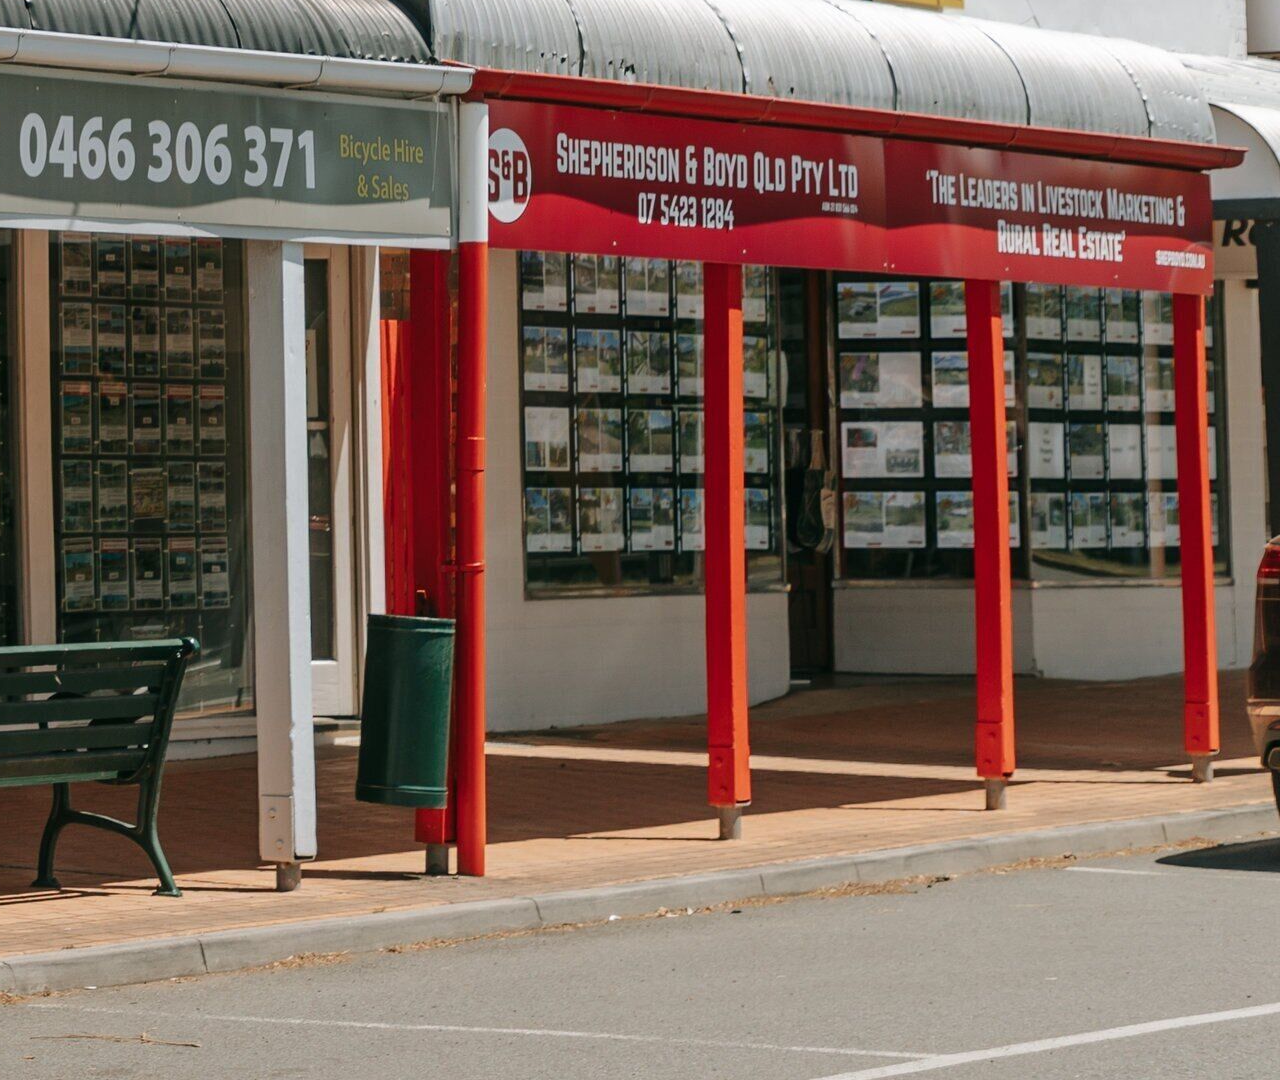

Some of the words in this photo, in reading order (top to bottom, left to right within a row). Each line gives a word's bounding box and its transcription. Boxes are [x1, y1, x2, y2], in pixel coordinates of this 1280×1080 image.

[19, 111, 136, 182] 0466
[147, 120, 233, 186] 306
[243, 125, 316, 190] 371
[340, 134, 391, 164] Bicycle
[394, 136, 425, 165] Hire
[556, 132, 680, 184] SHEPHERDSON
[686, 145, 698, 186] &
[703, 146, 748, 189] BOYD
[753, 151, 786, 195] QLD
[791, 155, 824, 195] PTY
[828, 158, 859, 199] LTD
[357, 175, 370, 199] &
[372, 174, 410, 201] Sales
[959, 172, 1018, 212] LEADERS
[1021, 183, 1035, 213] IN
[1037, 180, 1105, 220] LIVESTOCK
[1106, 188, 1175, 226] MARKETING
[1176, 195, 1185, 227] &
[637, 192, 653, 225] 07
[659, 195, 697, 228] 5423
[700, 198, 735, 231] 1284
[997, 219, 1040, 257] RURAL
[1043, 223, 1077, 259] REAL
